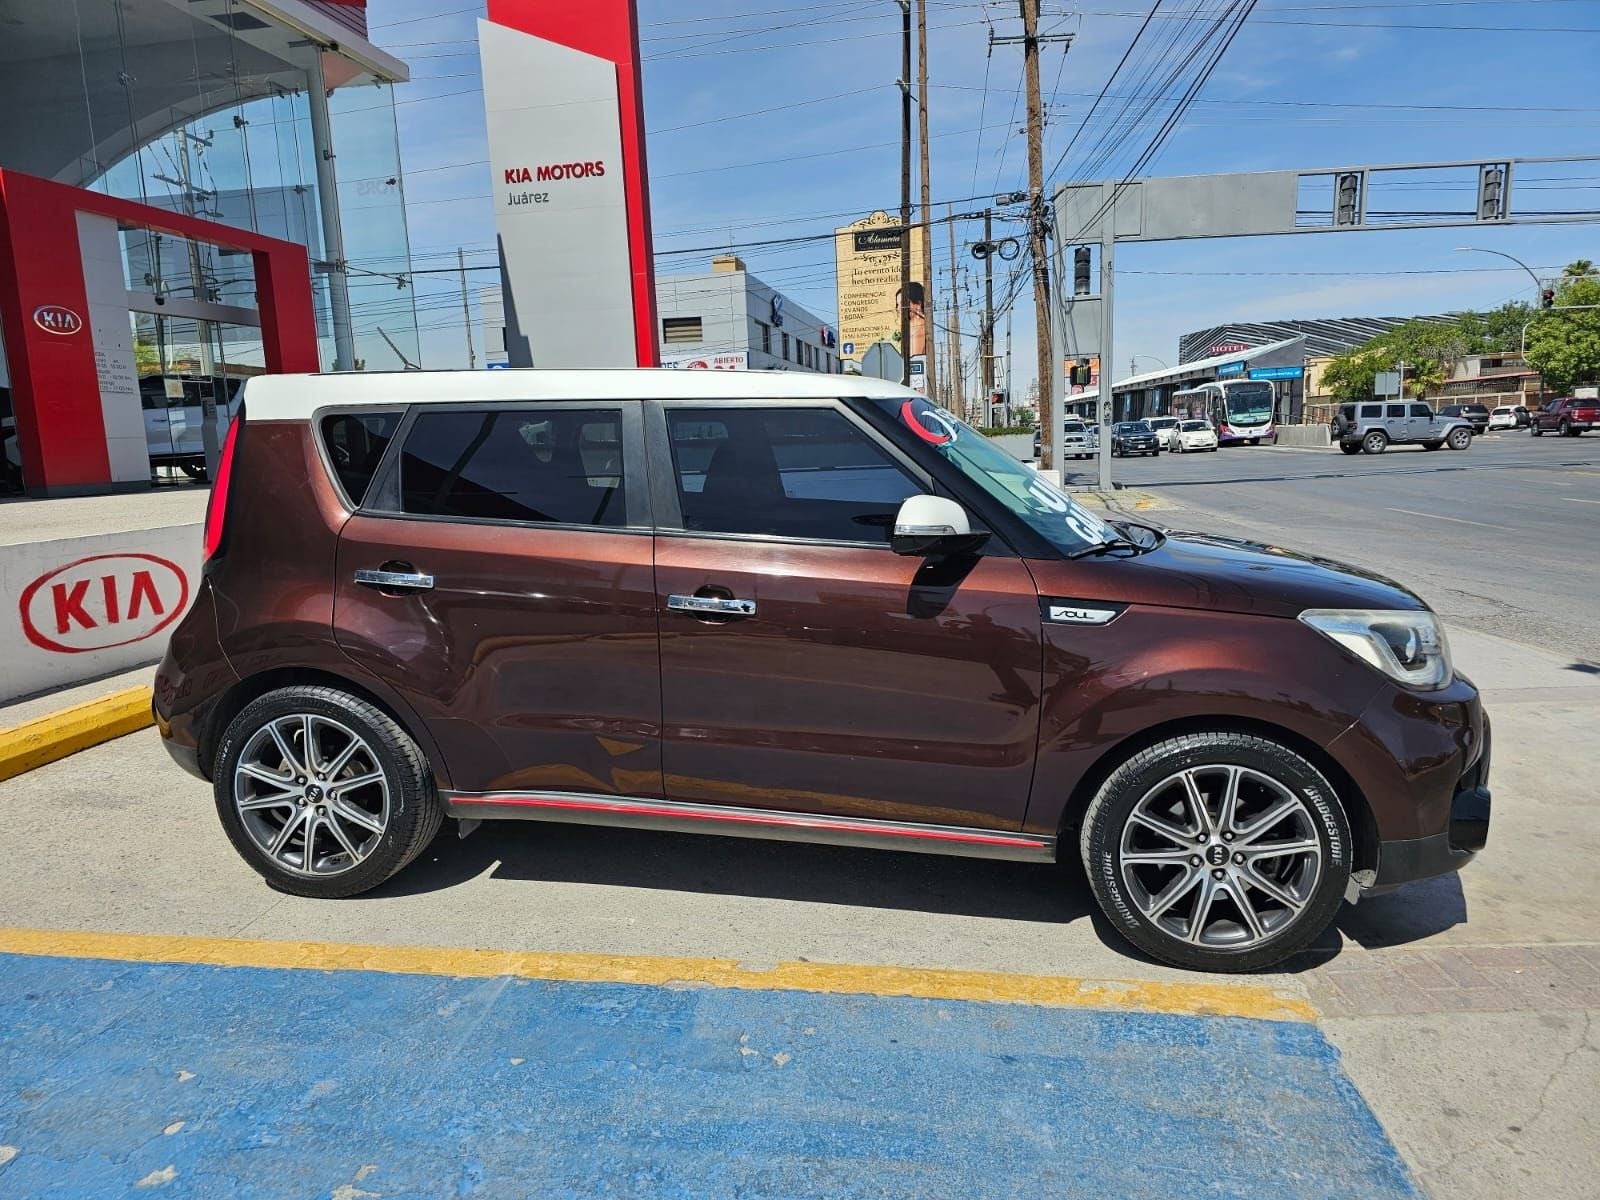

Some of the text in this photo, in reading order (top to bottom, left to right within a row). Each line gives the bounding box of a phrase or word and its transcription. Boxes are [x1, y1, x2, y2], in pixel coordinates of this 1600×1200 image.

[504, 160, 606, 184] KIA MOTORS
[507, 191, 550, 206] Juárez
[42, 311, 76, 329] KIA
[1211, 344, 1246, 353] HOTEL
[713, 356, 744, 364] ABIERTO
[51, 570, 165, 635] KIA
